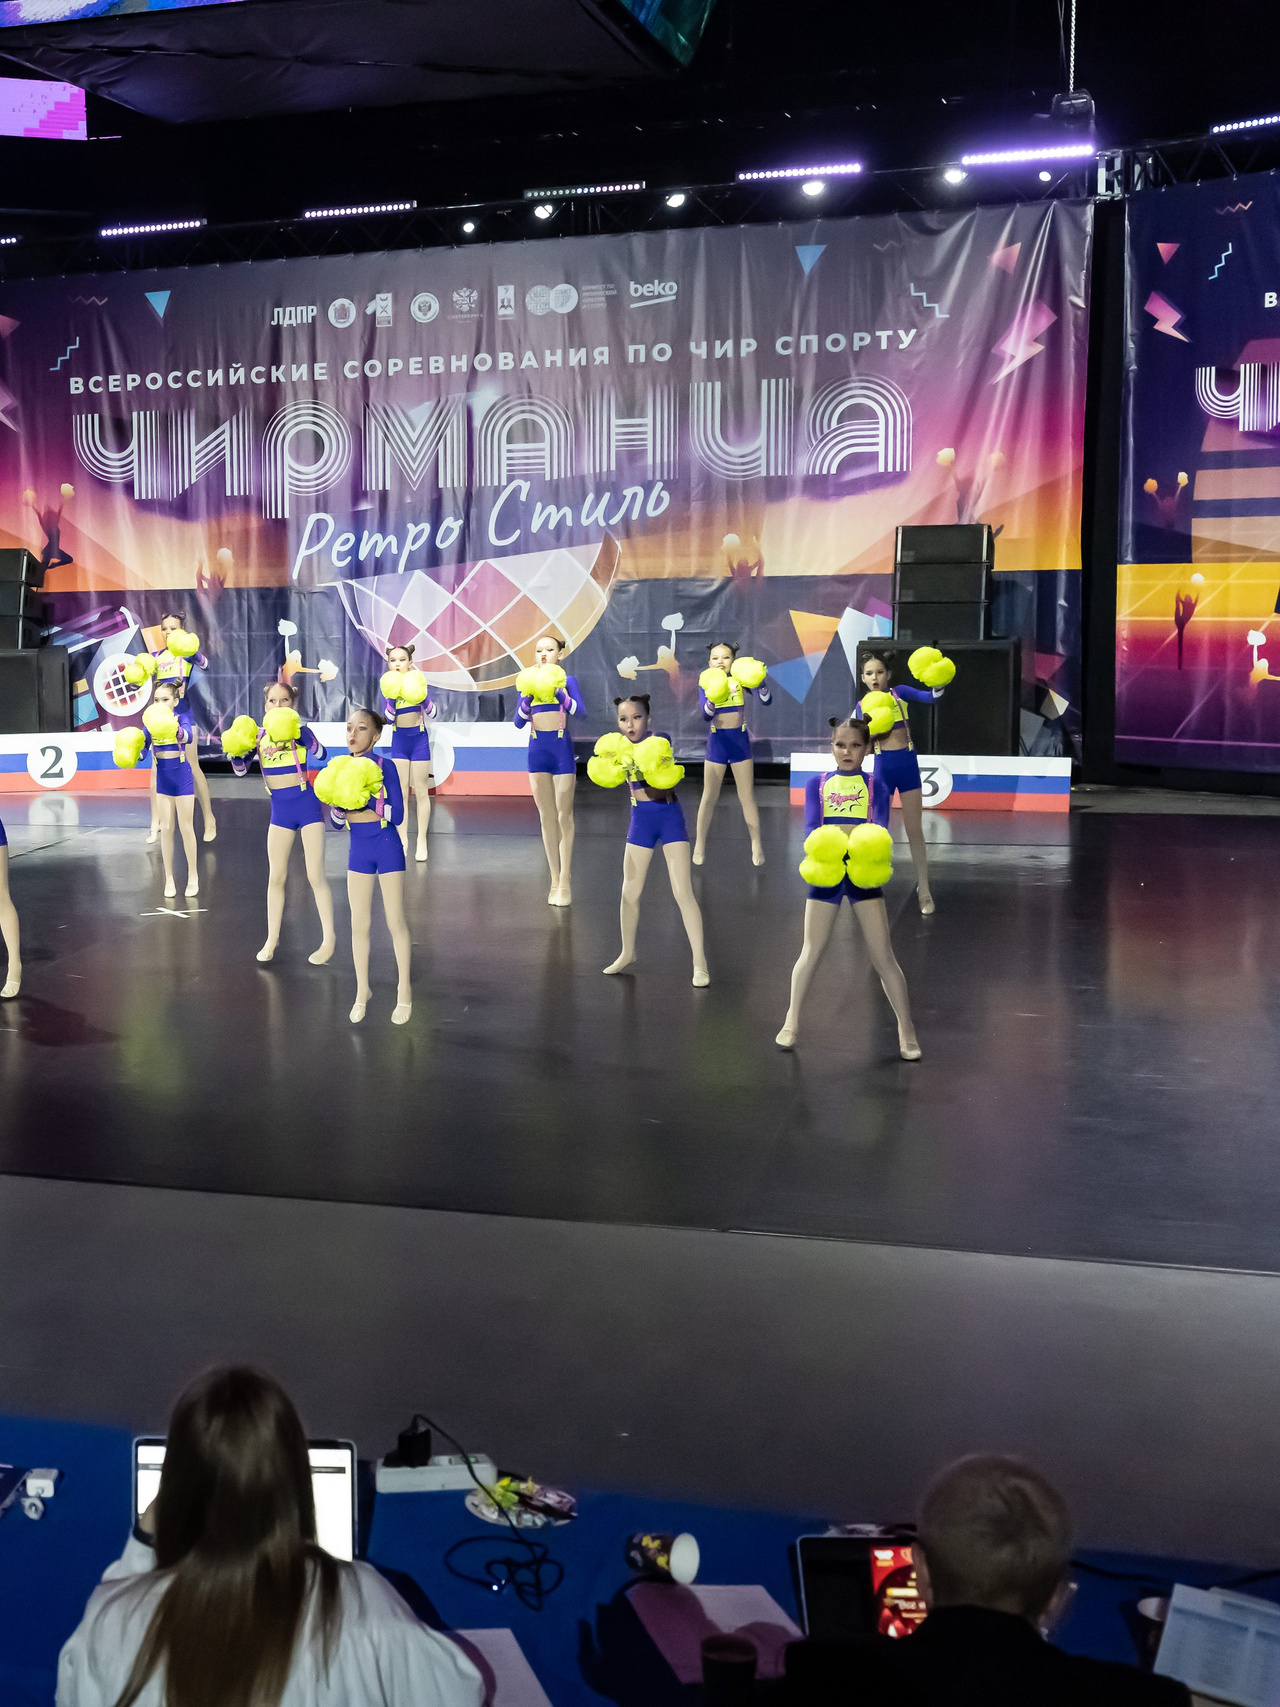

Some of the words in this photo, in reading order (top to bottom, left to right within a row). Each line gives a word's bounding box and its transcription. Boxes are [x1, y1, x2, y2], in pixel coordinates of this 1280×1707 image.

[629, 280, 678, 298] beko
[271, 306, 317, 326] ЛДПР
[70, 362, 328, 395] ВСЕРОССИЙСКИЕ
[342, 347, 611, 379] СОРЕВНОВАНИЯ
[628, 343, 672, 364] ПО
[690, 336, 758, 360] ЧИР
[775, 327, 918, 356] СПОРТУ
[292, 508, 462, 580] Ретро
[488, 478, 672, 548] Стиль
[40, 746, 64, 779] 2
